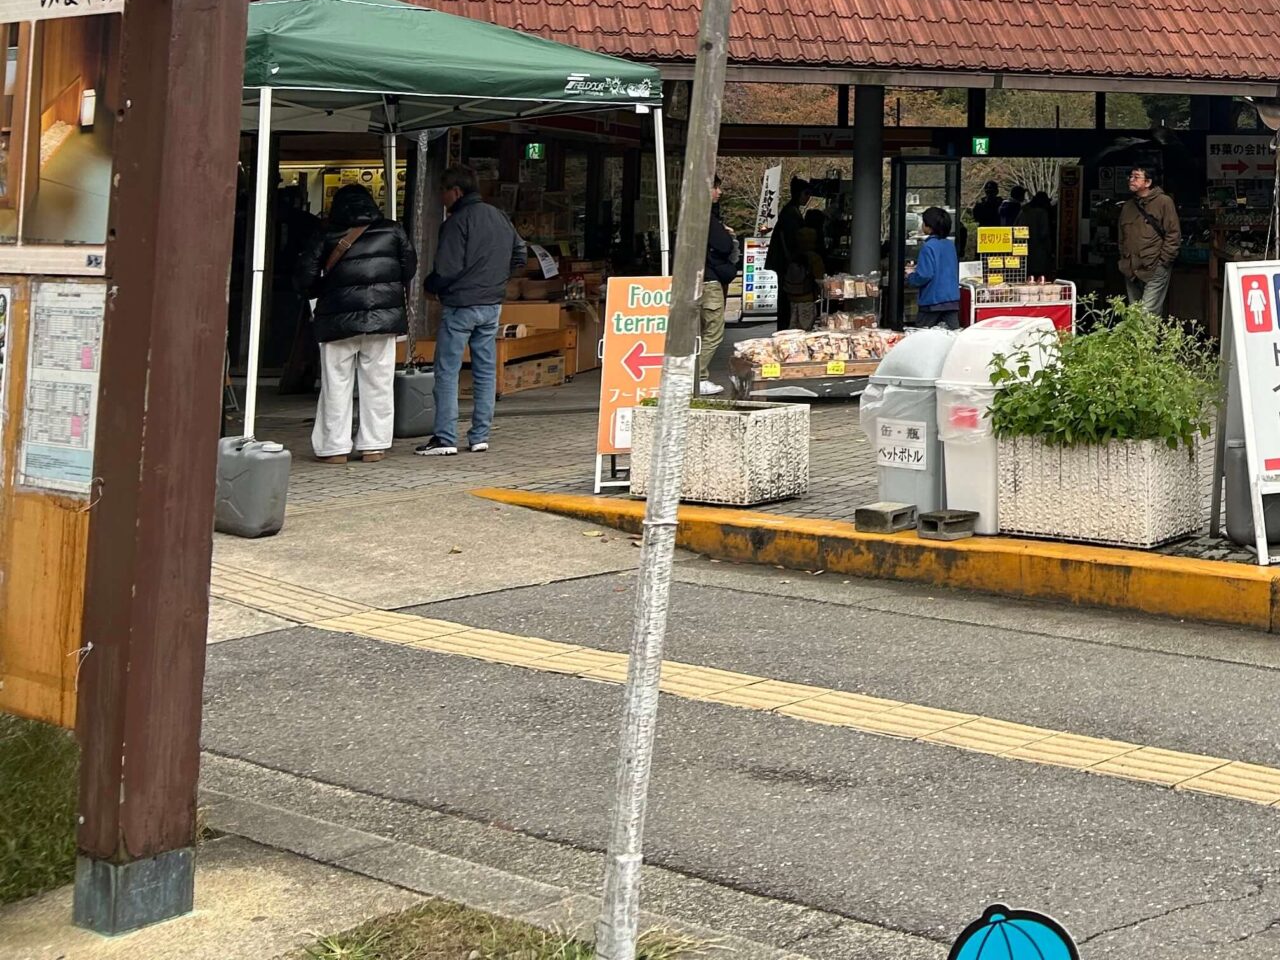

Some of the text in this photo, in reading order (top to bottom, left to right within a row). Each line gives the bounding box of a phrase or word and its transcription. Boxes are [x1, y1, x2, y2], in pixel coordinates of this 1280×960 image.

[980, 233, 1011, 244] 見切り品
[879, 446, 924, 463] ペットボトル
